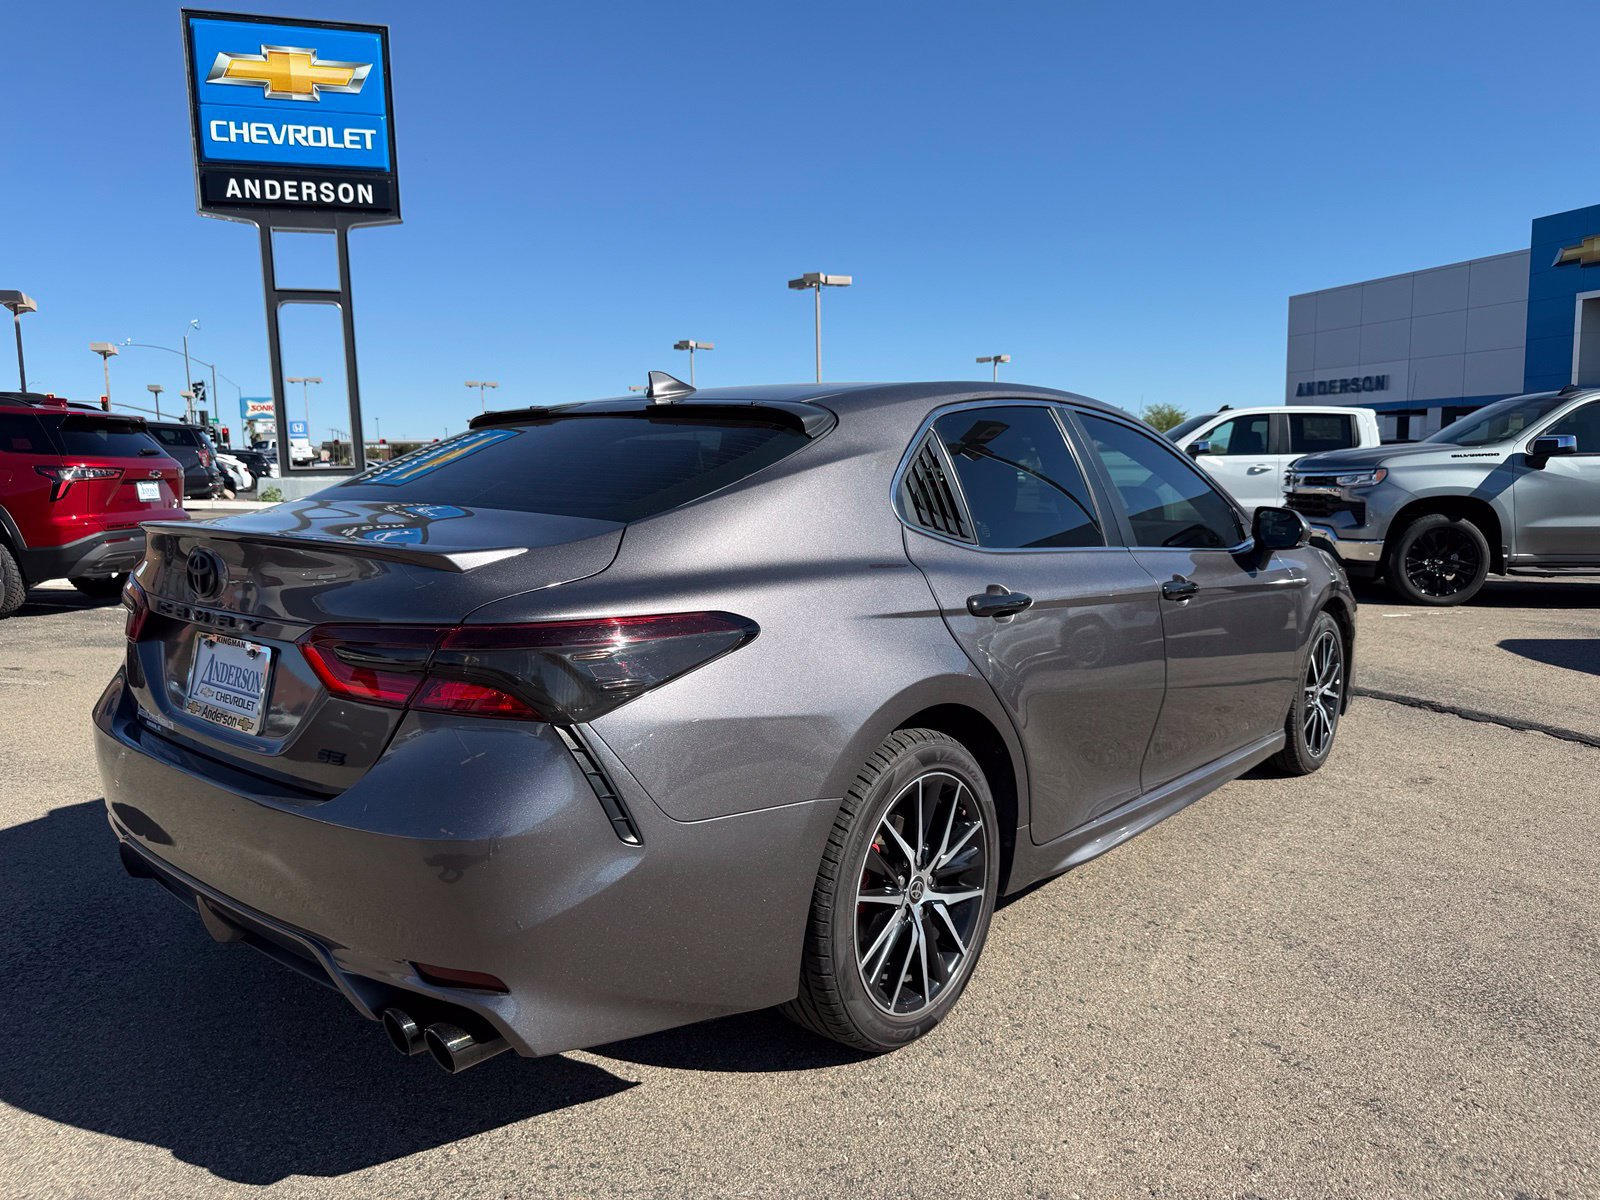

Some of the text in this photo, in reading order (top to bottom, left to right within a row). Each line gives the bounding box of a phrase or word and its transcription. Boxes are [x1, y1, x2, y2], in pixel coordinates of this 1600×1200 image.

[209, 120, 377, 150] CHEVROLET
[225, 178, 375, 204] ANDERSON
[1296, 374, 1387, 397] ANDERSON
[216, 636, 246, 649] KINGMAN
[194, 653, 263, 696] ANDERSON
[215, 691, 256, 711] CHEVROLET
[201, 705, 238, 728] Anderson
